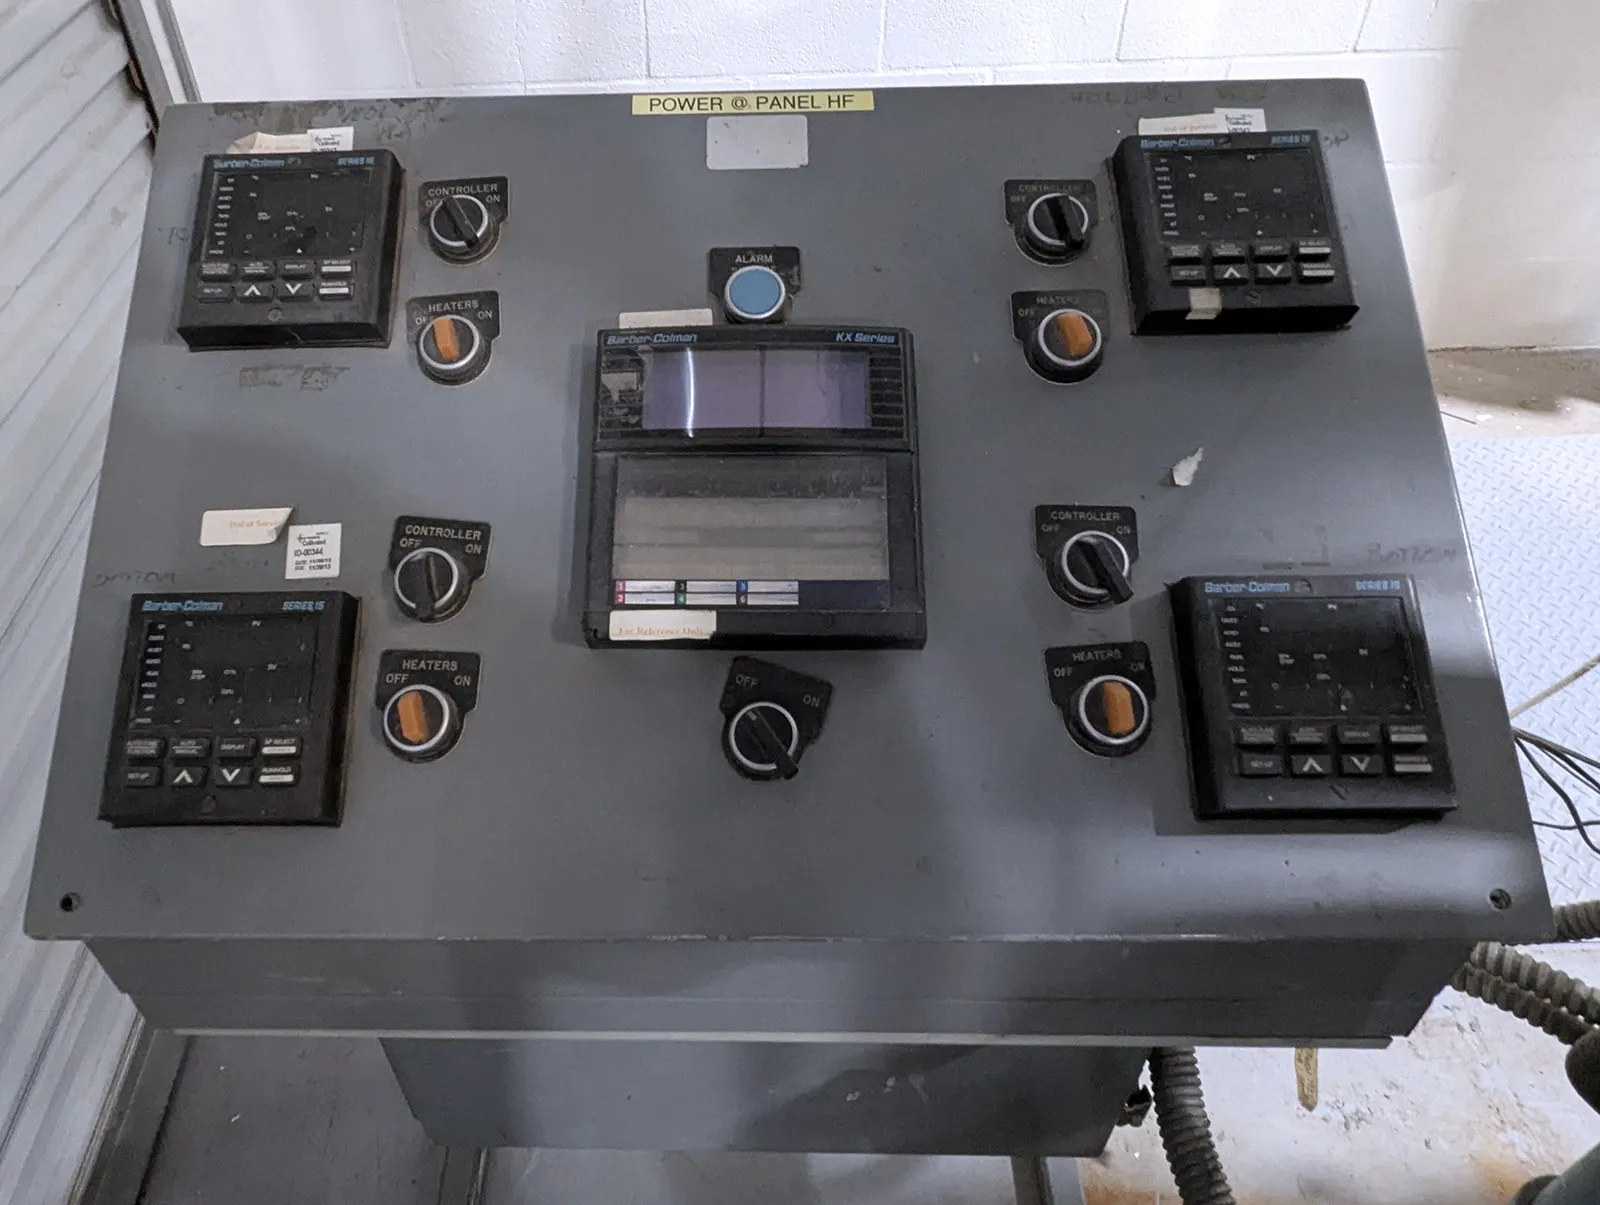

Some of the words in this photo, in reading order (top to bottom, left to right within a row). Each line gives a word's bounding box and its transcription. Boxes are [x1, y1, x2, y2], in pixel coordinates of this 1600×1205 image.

[649, 96, 723, 112] POWER
[731, 96, 748, 111] @
[756, 94, 821, 110] PANEL
[828, 94, 855, 109] HF
[1140, 137, 1215, 149] Barber-Colman
[428, 183, 499, 197] CONTROLLER
[486, 194, 501, 203] ON
[735, 254, 773, 264] ALARM
[428, 299, 480, 312] HEATERS
[477, 309, 493, 320] ON
[606, 333, 698, 345] Barber-Colman
[836, 332, 852, 342] KX
[854, 333, 895, 344] Series
[1050, 510, 1120, 521] CONTROLLER
[405, 525, 482, 541] CONTROLLER
[1040, 523, 1060, 533] OFF
[1115, 525, 1131, 535] ON
[400, 537, 421, 549] OFF
[465, 544, 482, 554] ON
[1204, 581, 1290, 594] Barber-Colman
[1355, 580, 1388, 591] SERIES
[142, 600, 224, 612] Barber-Colman
[282, 600, 313, 611] SERIES
[618, 626, 634, 637] For
[636, 626, 681, 636] Reference
[1072, 648, 1122, 662] HEATERS
[402, 659, 458, 671] HEATERS
[1129, 662, 1145, 674] ON
[1053, 666, 1073, 677] OFF
[385, 673, 410, 684] OFF
[454, 675, 472, 687] ON
[735, 674, 760, 689] OFF
[803, 694, 821, 708] ON
